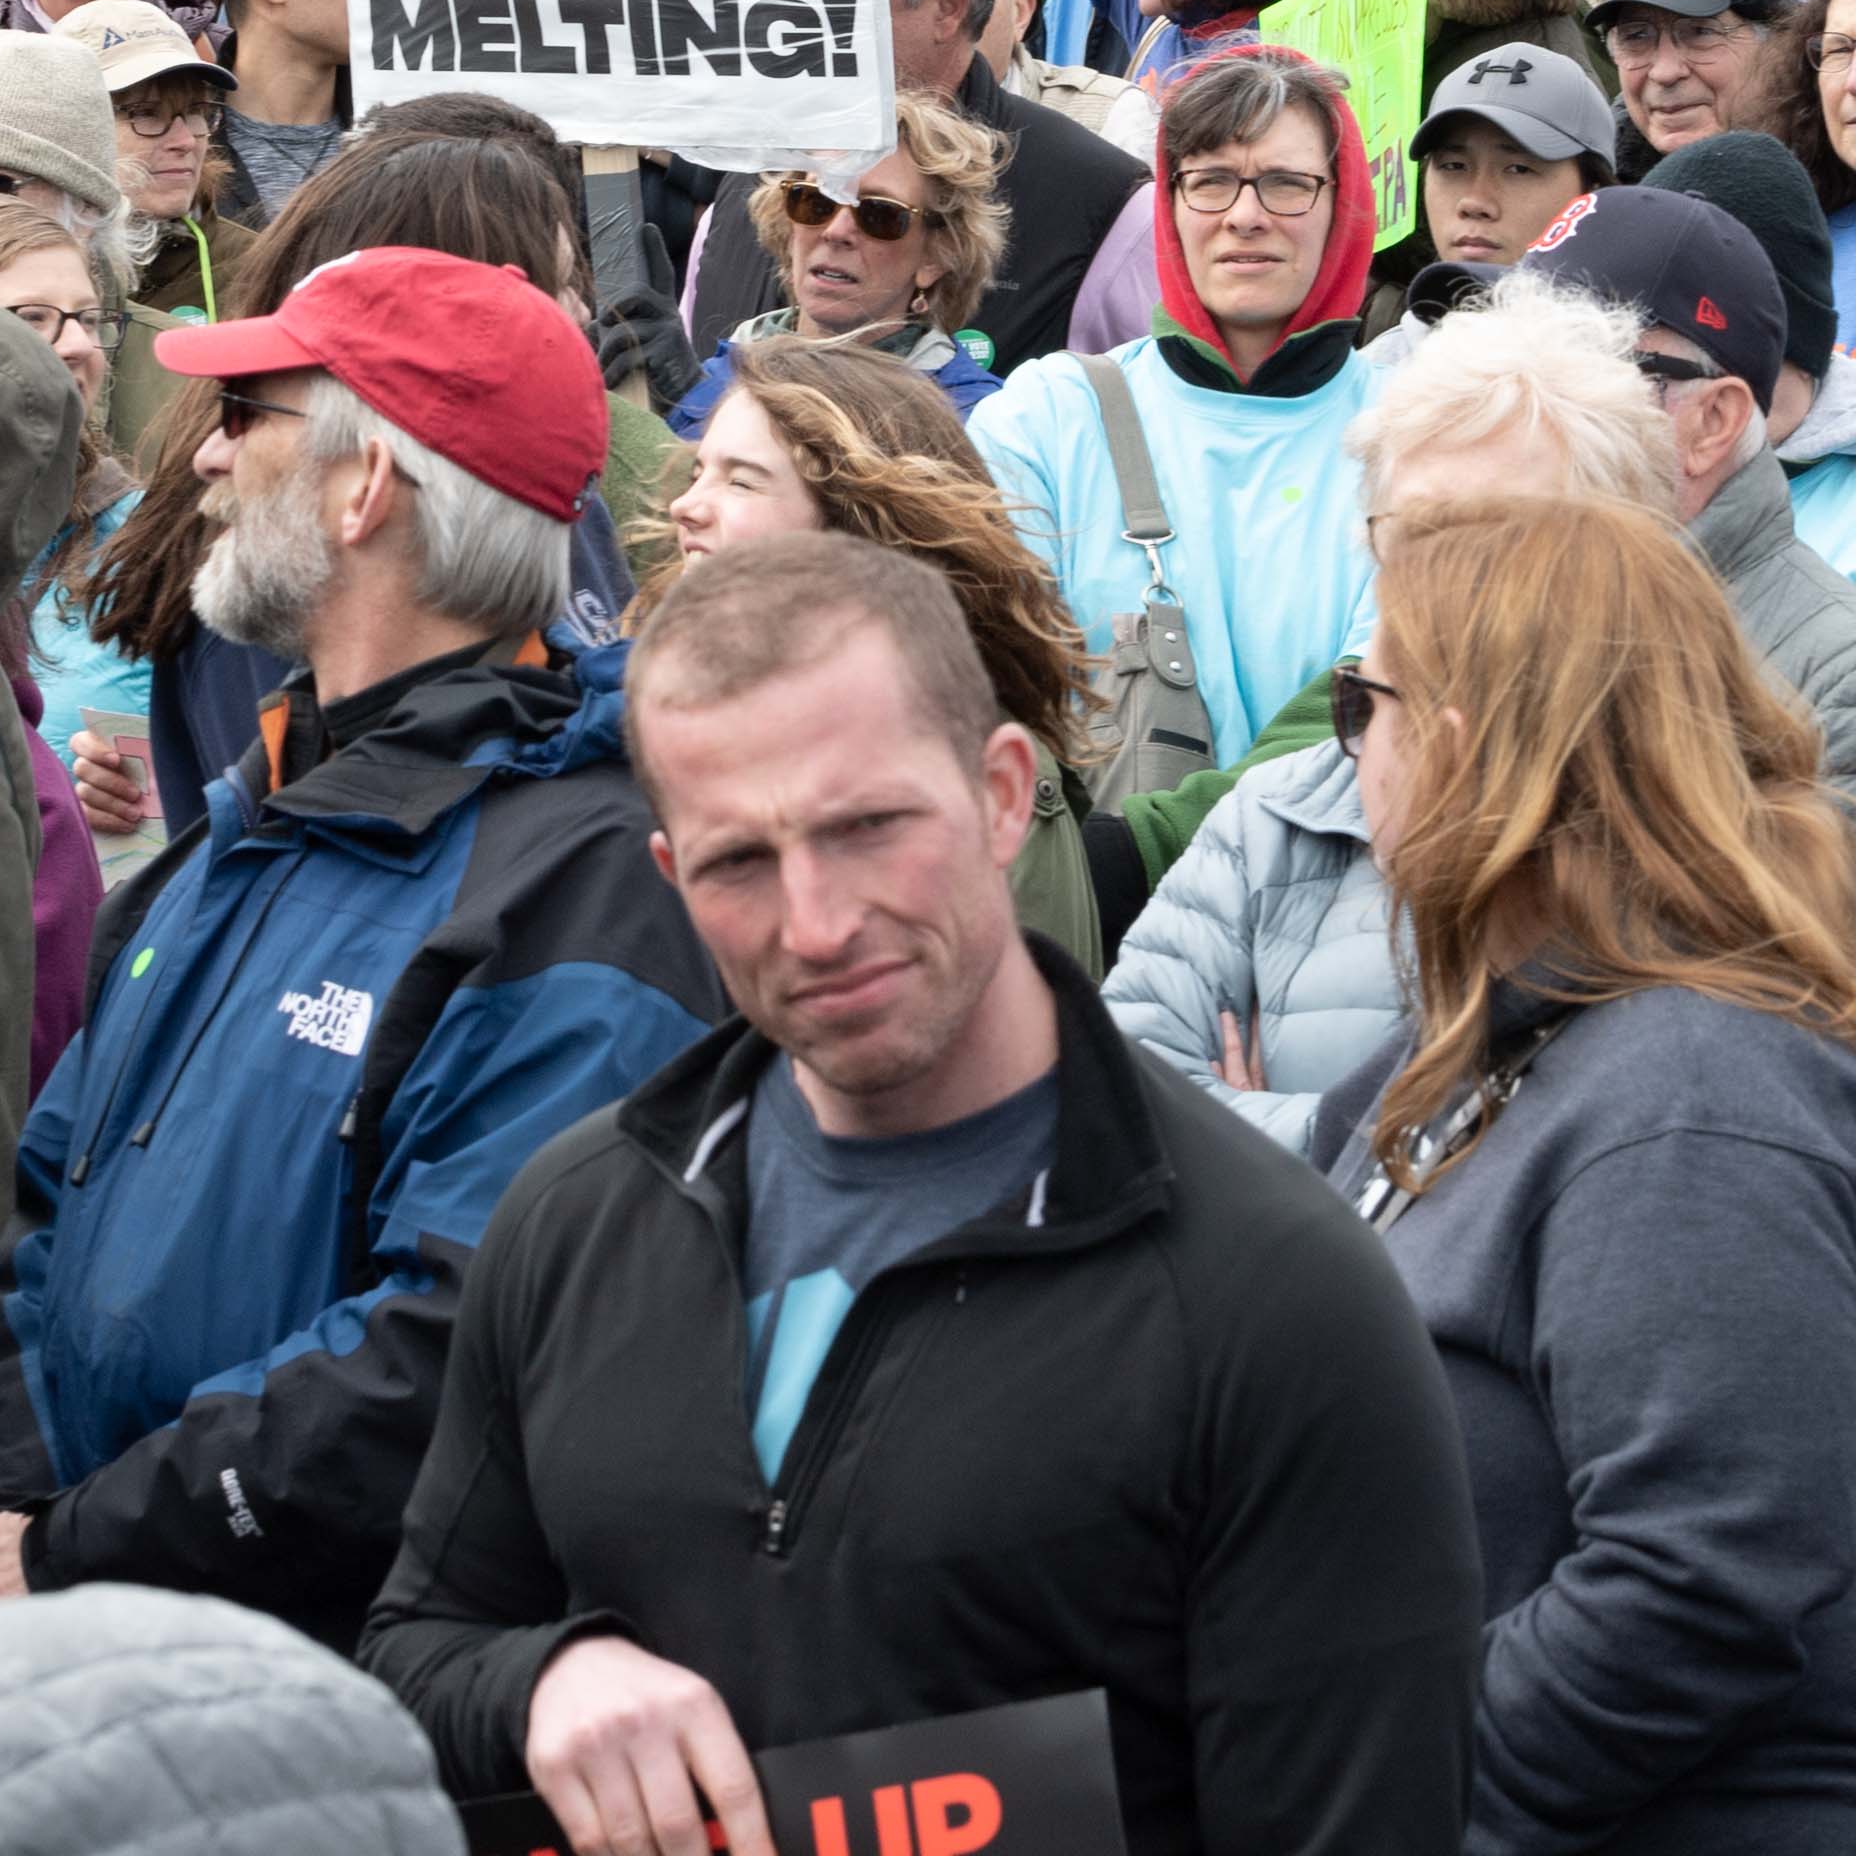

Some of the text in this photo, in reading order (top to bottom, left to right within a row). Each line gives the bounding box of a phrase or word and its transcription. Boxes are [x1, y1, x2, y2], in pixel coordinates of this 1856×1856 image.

[276, 990, 356, 1033] NORTH
[321, 980, 364, 1013] THE
[287, 1015, 348, 1053] FACE
